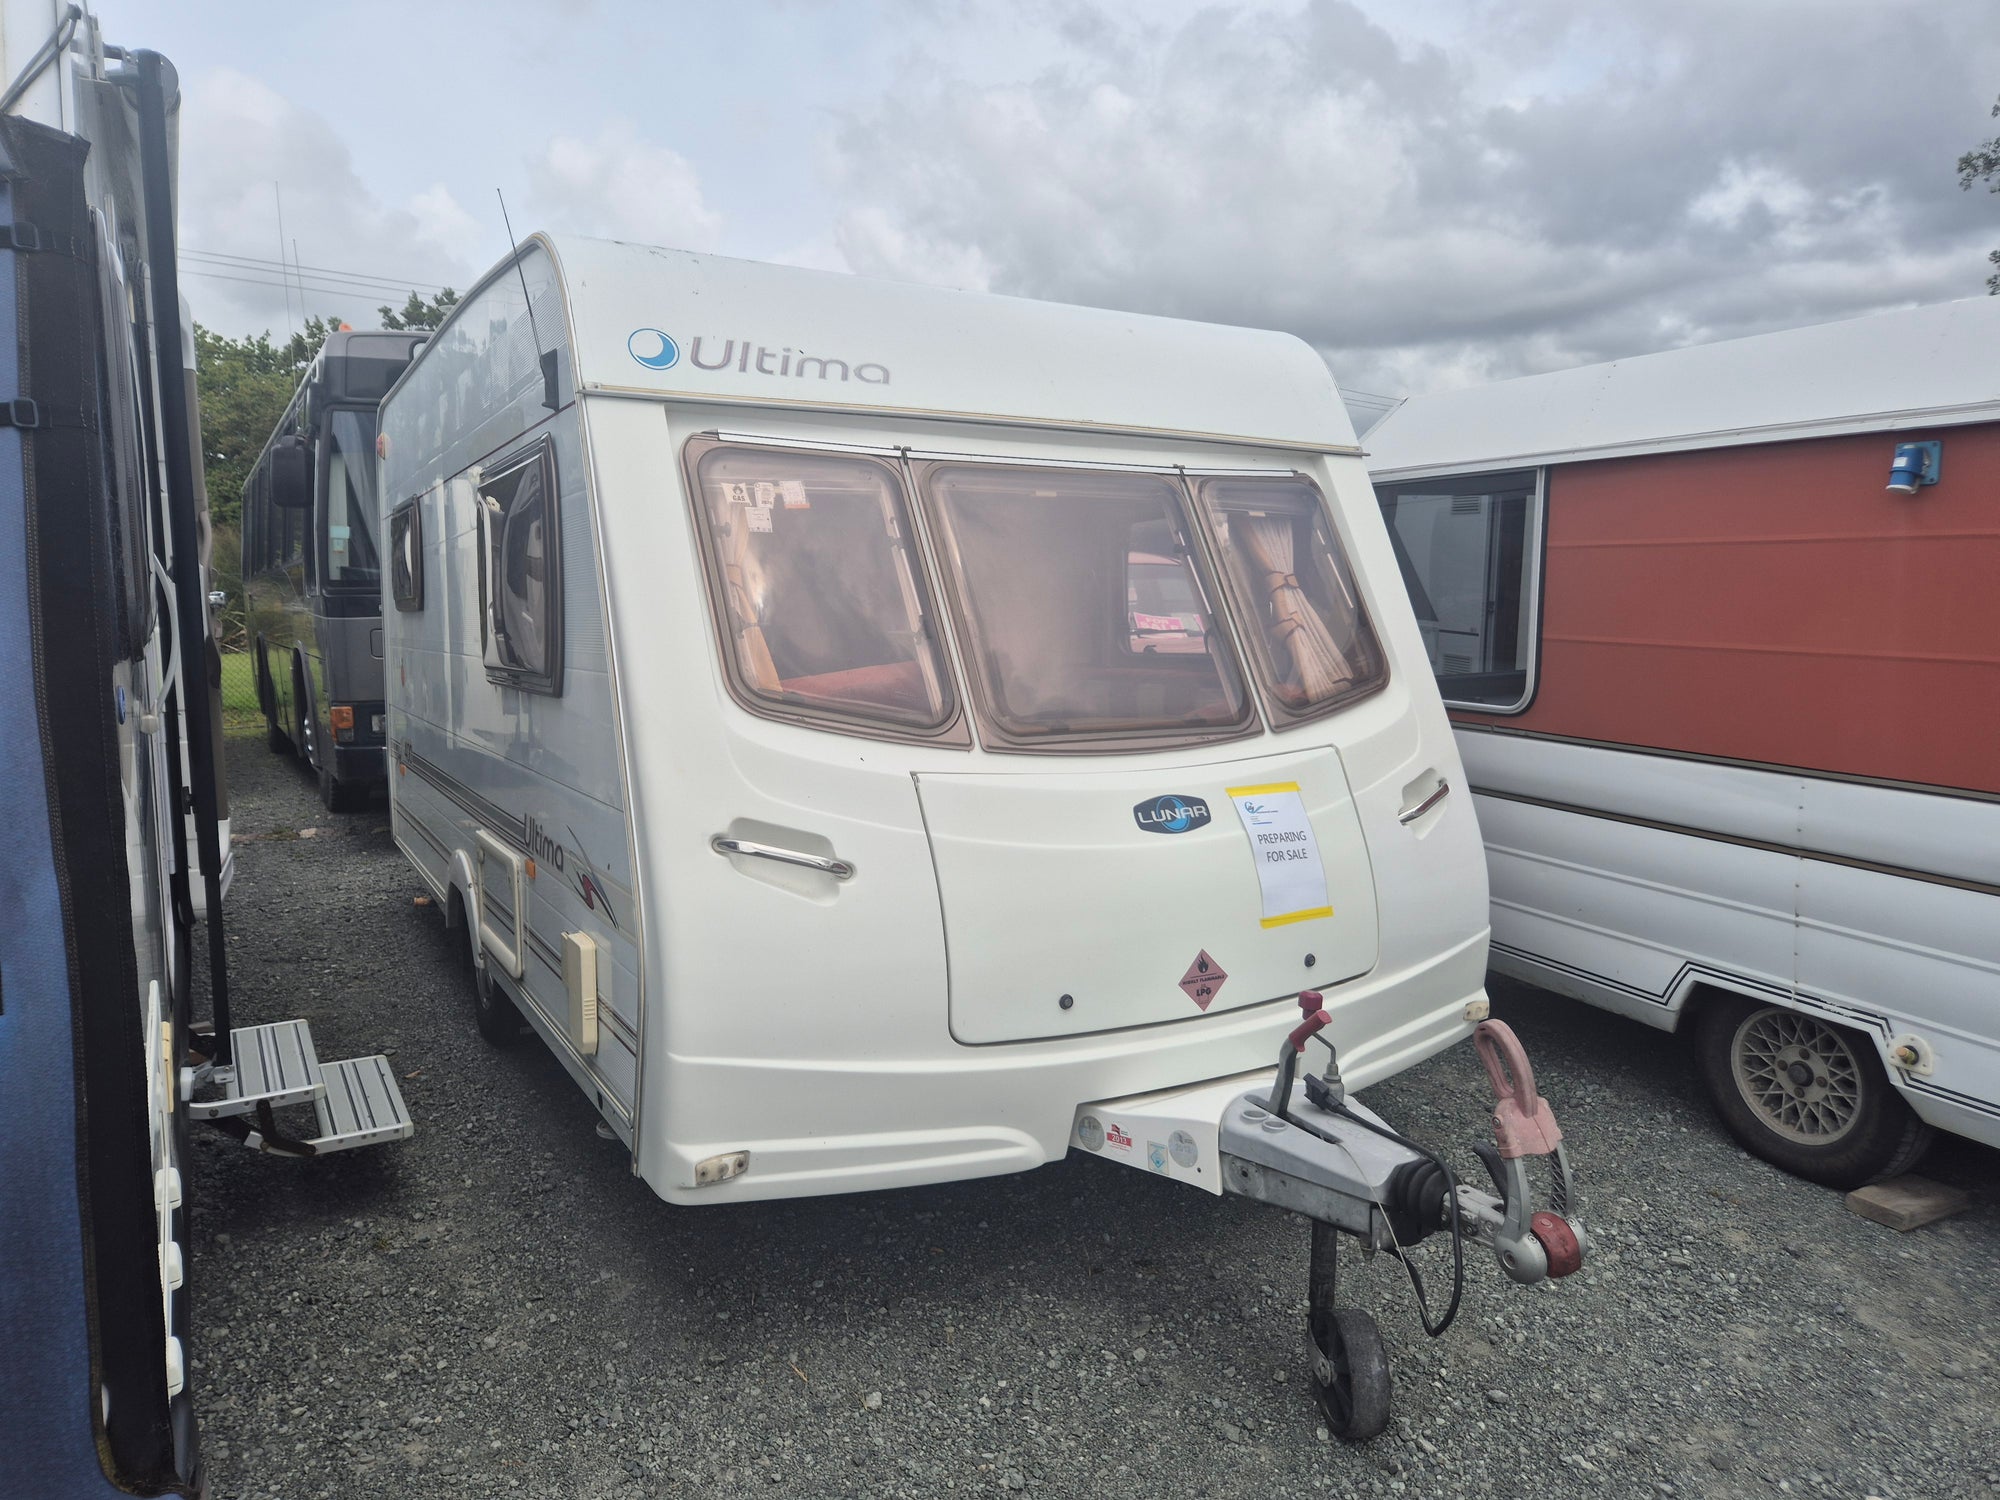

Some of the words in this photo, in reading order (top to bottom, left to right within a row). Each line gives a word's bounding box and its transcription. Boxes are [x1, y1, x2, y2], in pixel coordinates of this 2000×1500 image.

[689, 336, 890, 385] Ultima
[1137, 805, 1208, 823] LUNAR
[524, 812, 564, 874] Ultima
[1257, 830, 1307, 845] PREPARING
[1266, 850, 1286, 862] FOR
[1286, 848, 1308, 861] SALE
[1196, 987, 1211, 996] LPG
[1111, 1134, 1128, 1144] 2013
